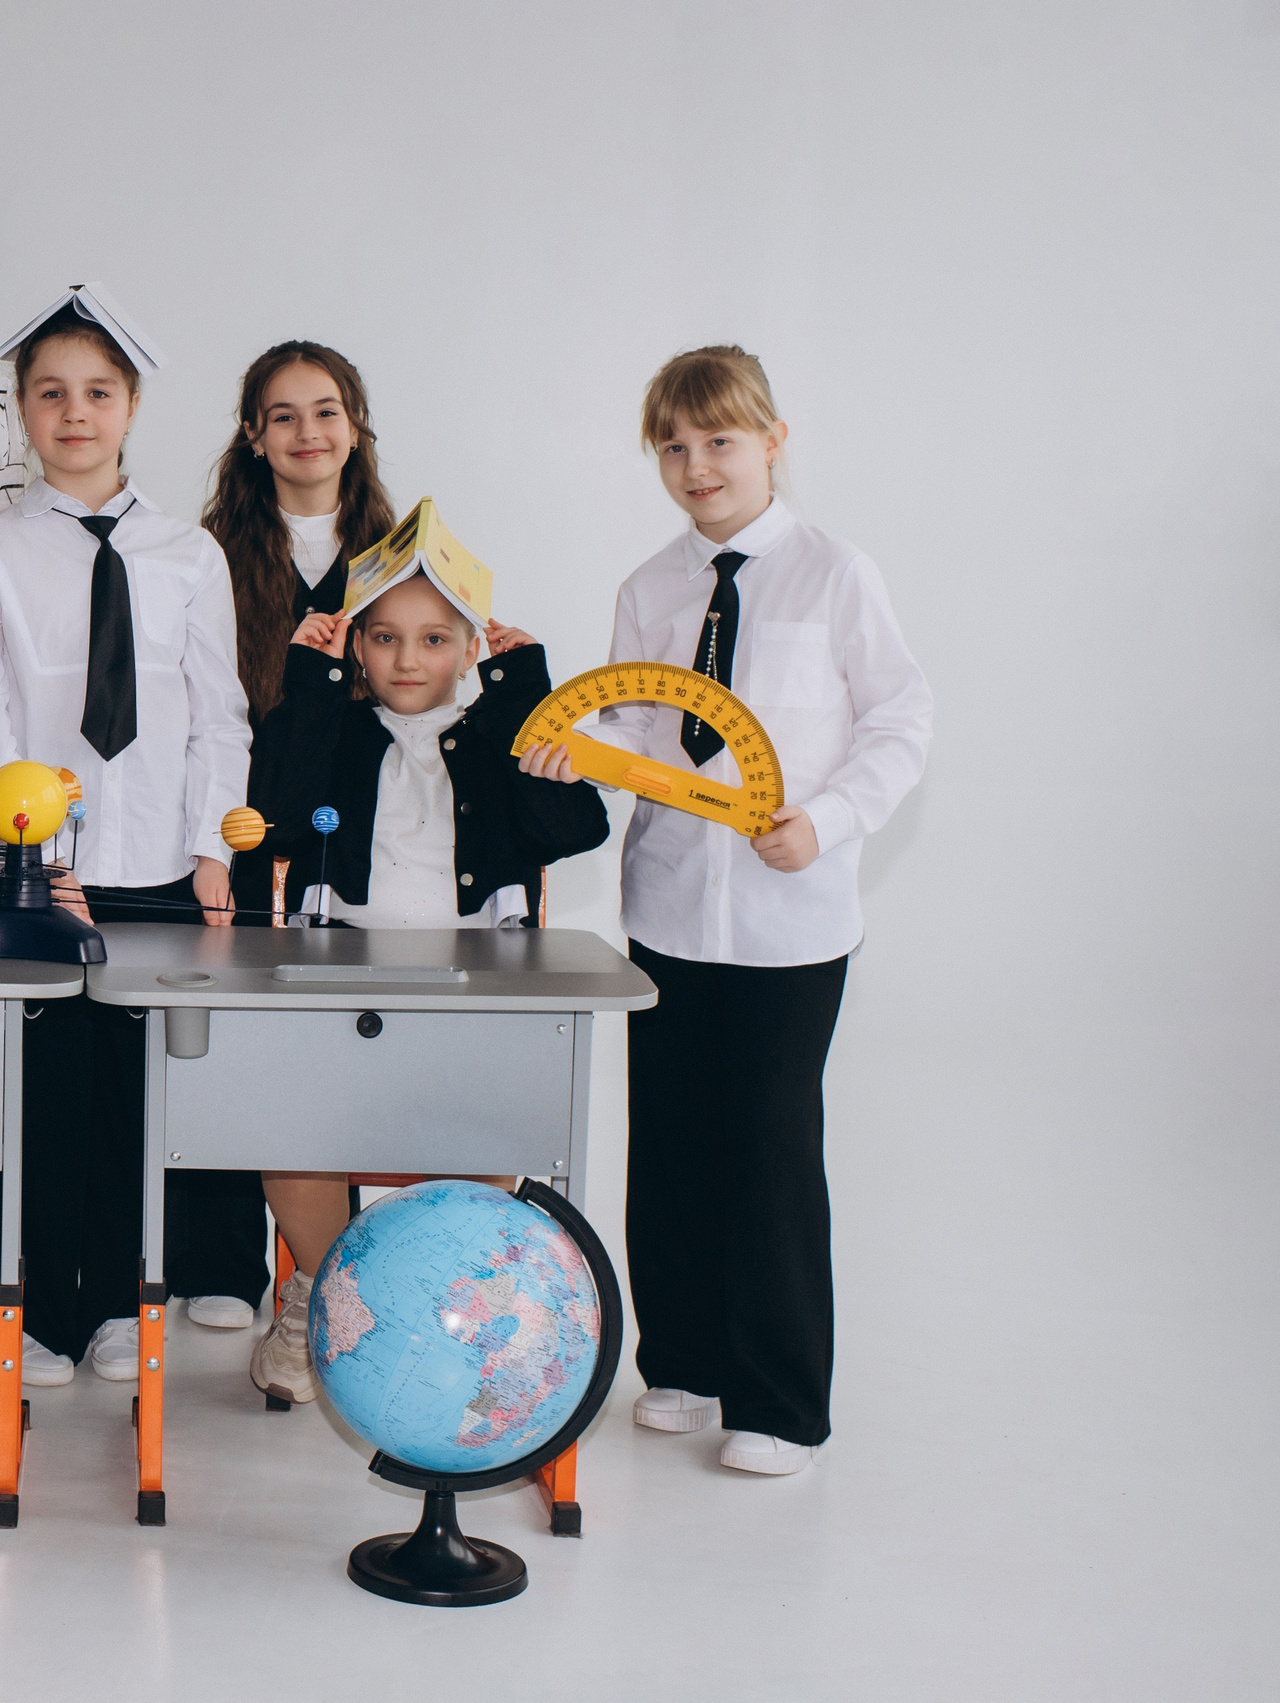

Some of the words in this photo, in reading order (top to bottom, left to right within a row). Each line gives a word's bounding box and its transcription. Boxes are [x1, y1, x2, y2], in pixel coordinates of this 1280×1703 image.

[596, 685, 605, 693] 50
[617, 688, 627, 696] 120
[675, 687, 687, 698] 90
[599, 693, 609, 701] 130
[696, 692, 706, 702] 100
[562, 705, 570, 713] 30
[581, 701, 592, 709] 140
[692, 700, 701, 709] 80
[714, 704, 723, 713] 110
[566, 711, 577, 720] 150
[710, 711, 717, 719] 70
[548, 719, 556, 727] 20
[554, 723, 563, 732] 160
[729, 718, 739, 728] 120
[722, 724, 731, 733] 60
[734, 739, 742, 748] 50
[741, 734, 751, 744] 130
[743, 755, 750, 764] 40
[751, 752, 759, 762] 140
[748, 774, 756, 782] 30
[757, 771, 765, 781] 150
[688, 789, 694, 797] 1
[695, 792, 731, 808] вересня
[750, 791, 757, 800] 20
[758, 810, 766, 820] 170
[754, 826, 763, 836] 180
